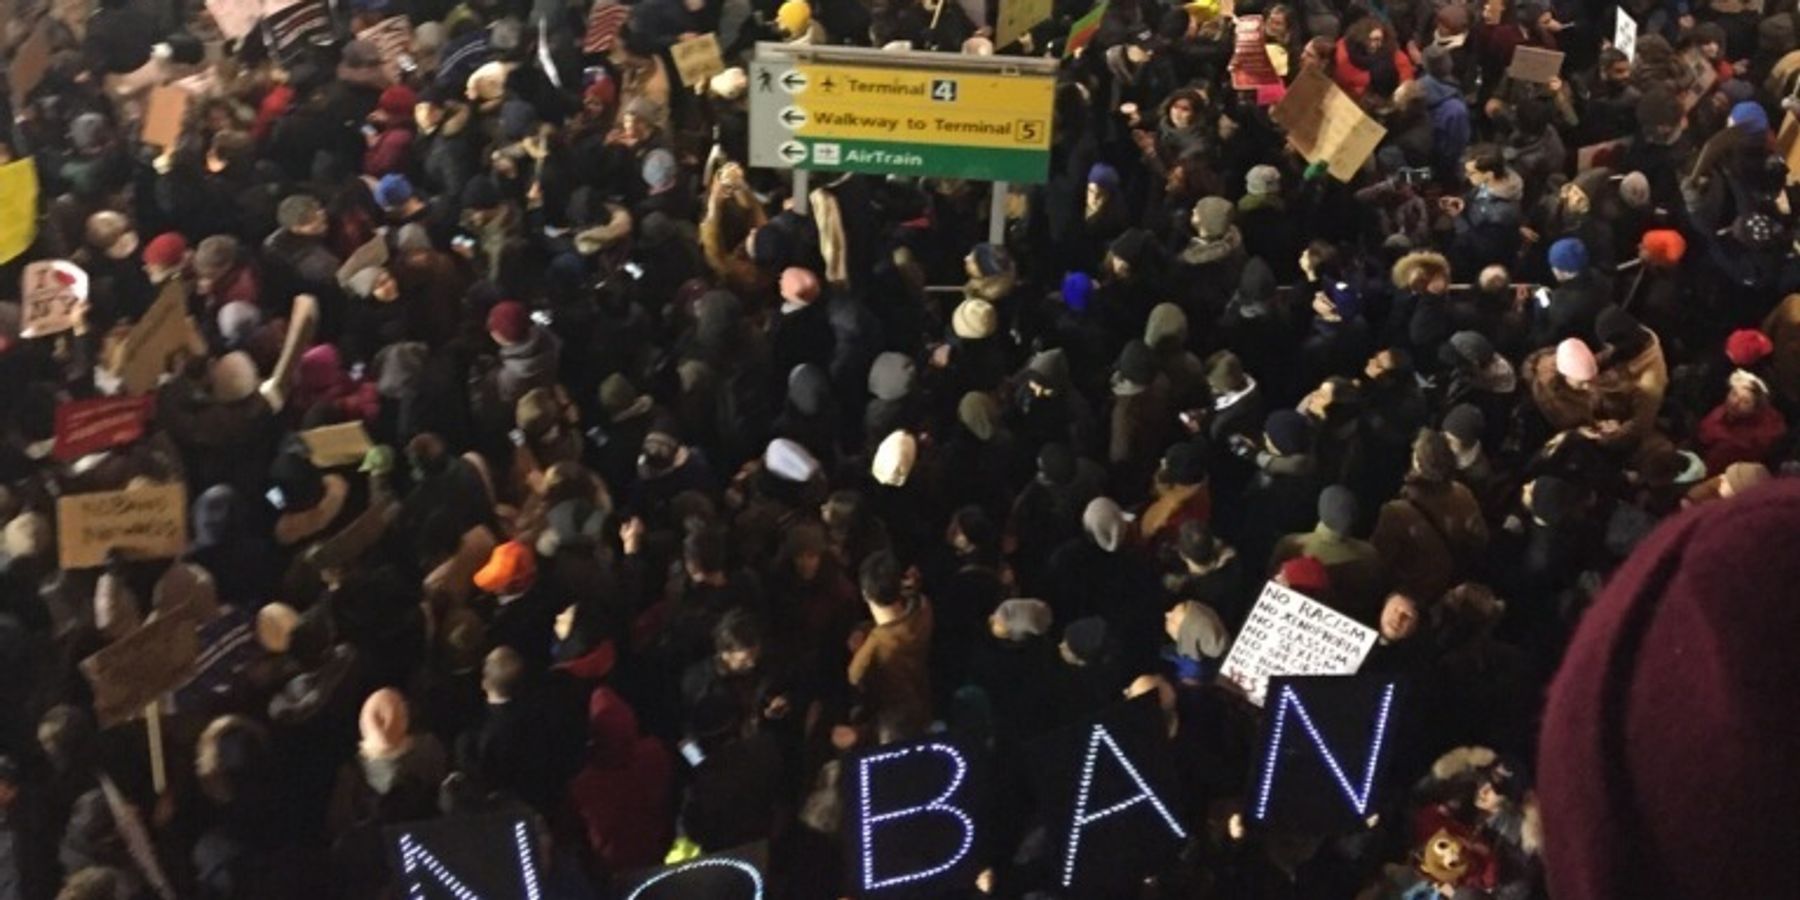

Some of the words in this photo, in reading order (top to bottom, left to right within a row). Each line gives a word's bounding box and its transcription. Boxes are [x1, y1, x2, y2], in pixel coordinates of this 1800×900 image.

[848, 79, 925, 96] Terminal
[933, 80, 954, 101] 4
[813, 111, 898, 132] Walkway
[906, 116, 926, 131] to
[935, 118, 1012, 136] Terminal
[1021, 123, 1036, 140] 5
[845, 150, 923, 166] AirTrain
[1257, 600, 1278, 616] NO
[1265, 586, 1290, 605] NO
[1298, 600, 1366, 642] RACISM
[1239, 635, 1262, 651] NO
[1245, 624, 1268, 641] NO
[1251, 612, 1274, 630] NO
[1277, 625, 1348, 666] CLASSISM
[860, 682, 1395, 890] BAN
